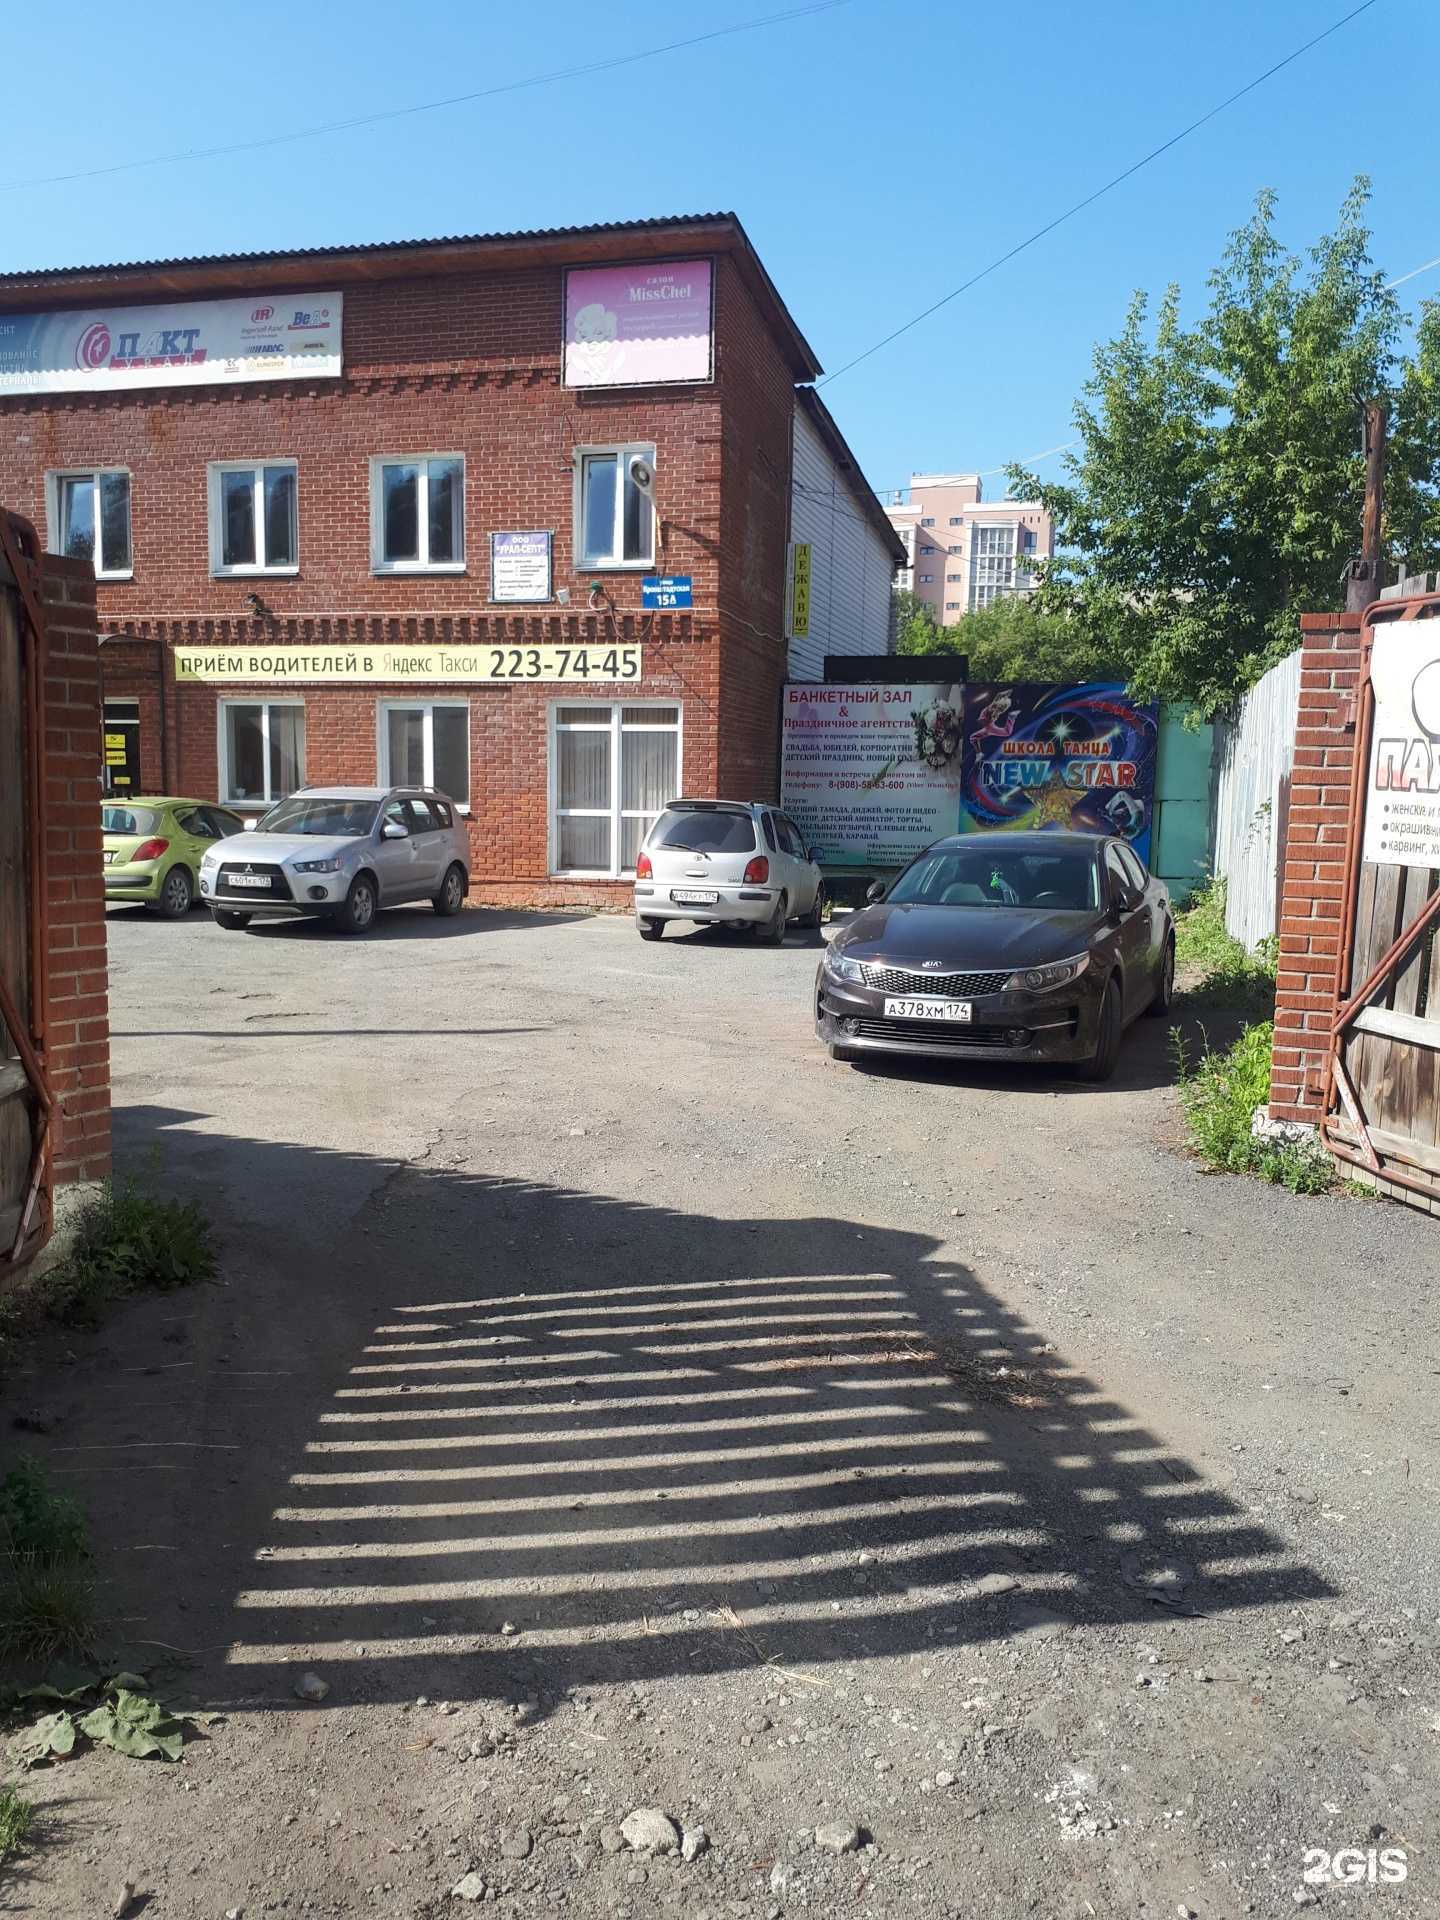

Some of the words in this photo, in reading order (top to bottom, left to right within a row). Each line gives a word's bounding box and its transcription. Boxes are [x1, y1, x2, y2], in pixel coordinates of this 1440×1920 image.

[181, 654, 243, 673] ПРИЁМ
[249, 653, 357, 676] ВОДИТЕЛЕЙ
[363, 657, 374, 672] В
[383, 653, 432, 674] Яндекс
[438, 652, 478, 672] Такси
[488, 649, 638, 678] 223-74-45
[789, 688, 880, 704] БАНКЕТНЫЙ
[882, 691, 912, 704] ЗАЛ
[838, 705, 849, 718] &
[784, 718, 858, 731] Праздничное
[860, 719, 918, 729] агентство
[1003, 741, 1055, 755] ШКОЛА
[1064, 741, 1112, 757] ТАНЦА
[981, 761, 1050, 786] NEW
[1066, 761, 1137, 787] STAR
[888, 1002, 944, 1017] А378ХМ
[946, 1004, 969, 1016] 174
